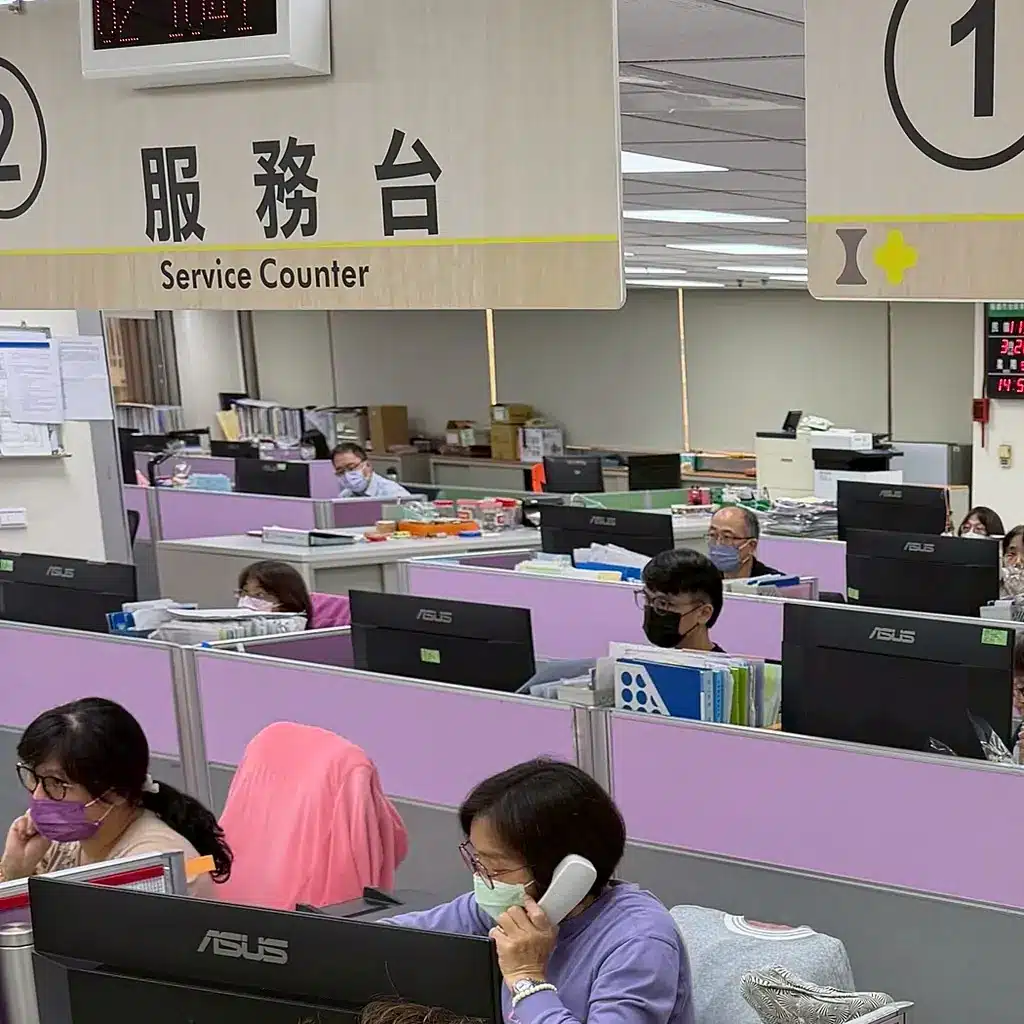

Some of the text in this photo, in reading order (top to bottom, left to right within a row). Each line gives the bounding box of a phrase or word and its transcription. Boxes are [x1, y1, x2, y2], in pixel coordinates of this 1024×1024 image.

[950, 0, 996, 117] 1
[141, 129, 442, 242] 服務台
[160, 258, 369, 290] Service Counter
[590, 515, 616, 527] ASUS
[904, 541, 935, 553] ASUS
[47, 565, 75, 579] ASUS
[416, 608, 453, 624] ASUS
[868, 626, 916, 644] ASUS
[197, 929, 289, 965] ASUS
